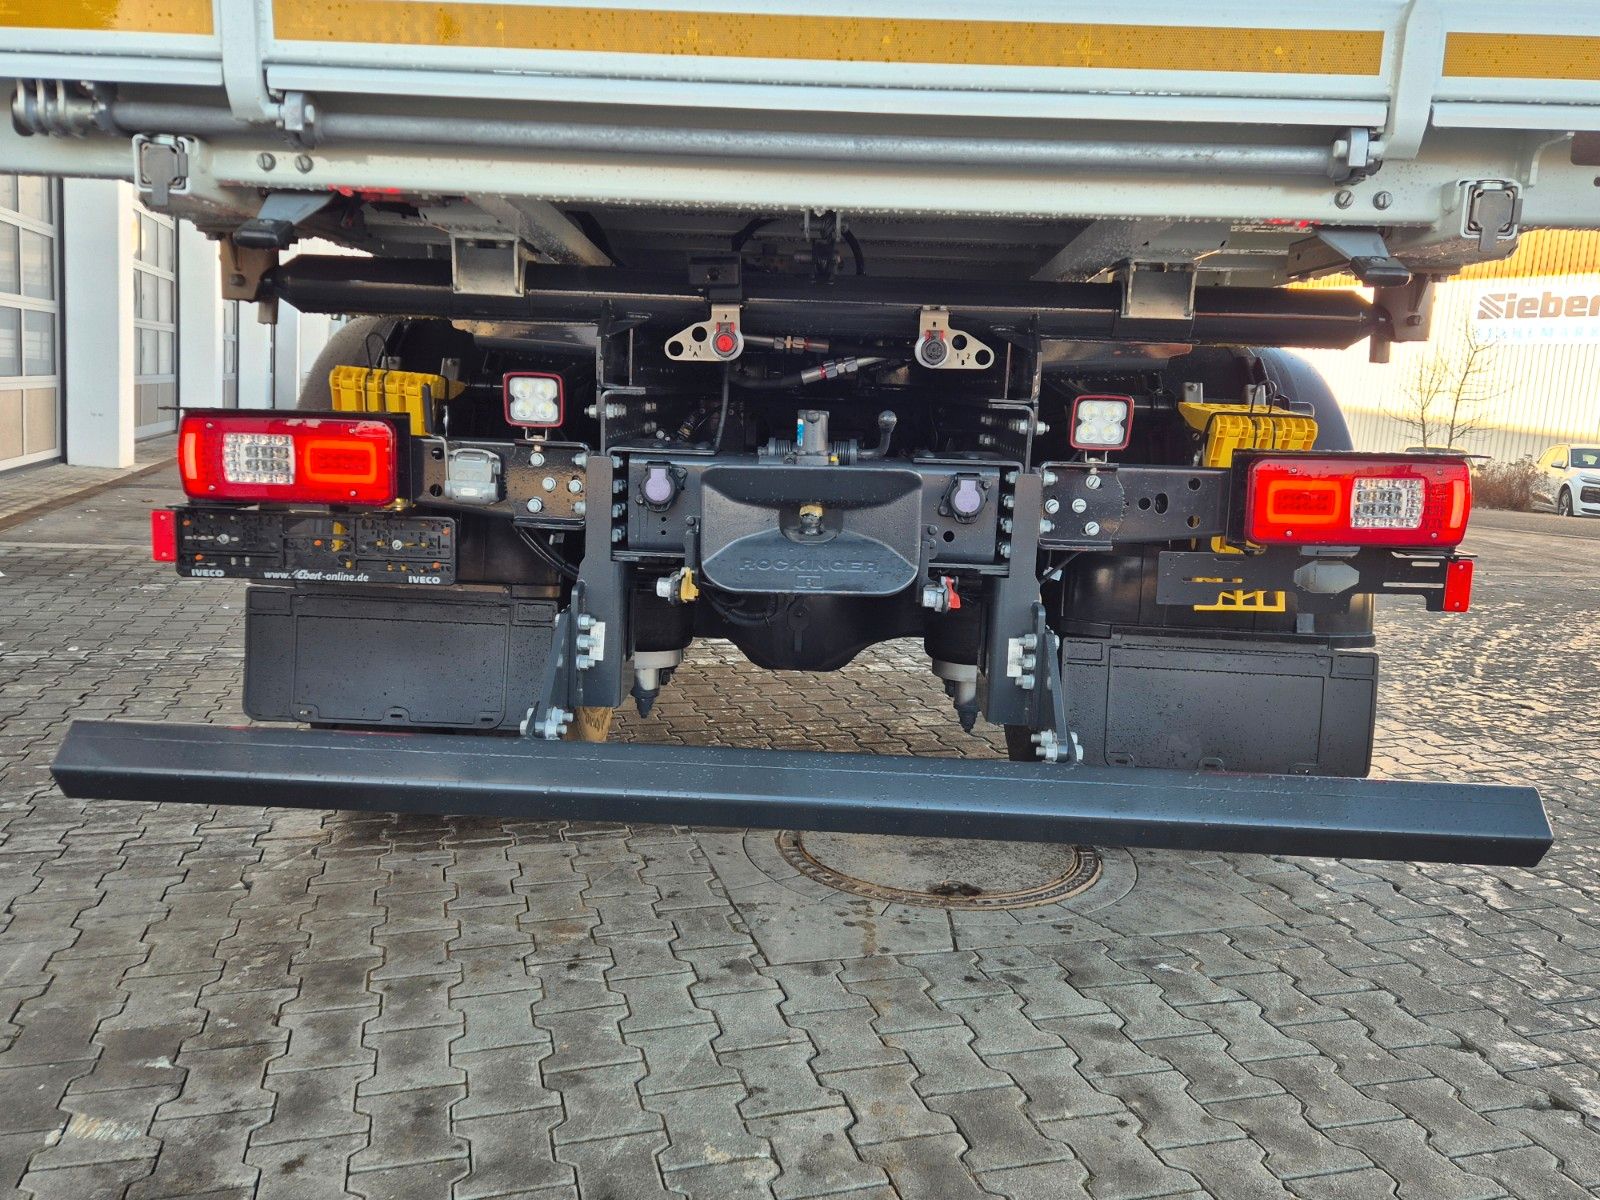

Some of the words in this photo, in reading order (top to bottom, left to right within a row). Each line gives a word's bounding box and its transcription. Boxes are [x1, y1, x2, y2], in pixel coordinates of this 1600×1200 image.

[739, 558, 879, 573] ROCKINGER
[191, 568, 225, 578] IVECO
[408, 575, 441, 585] IVECO
